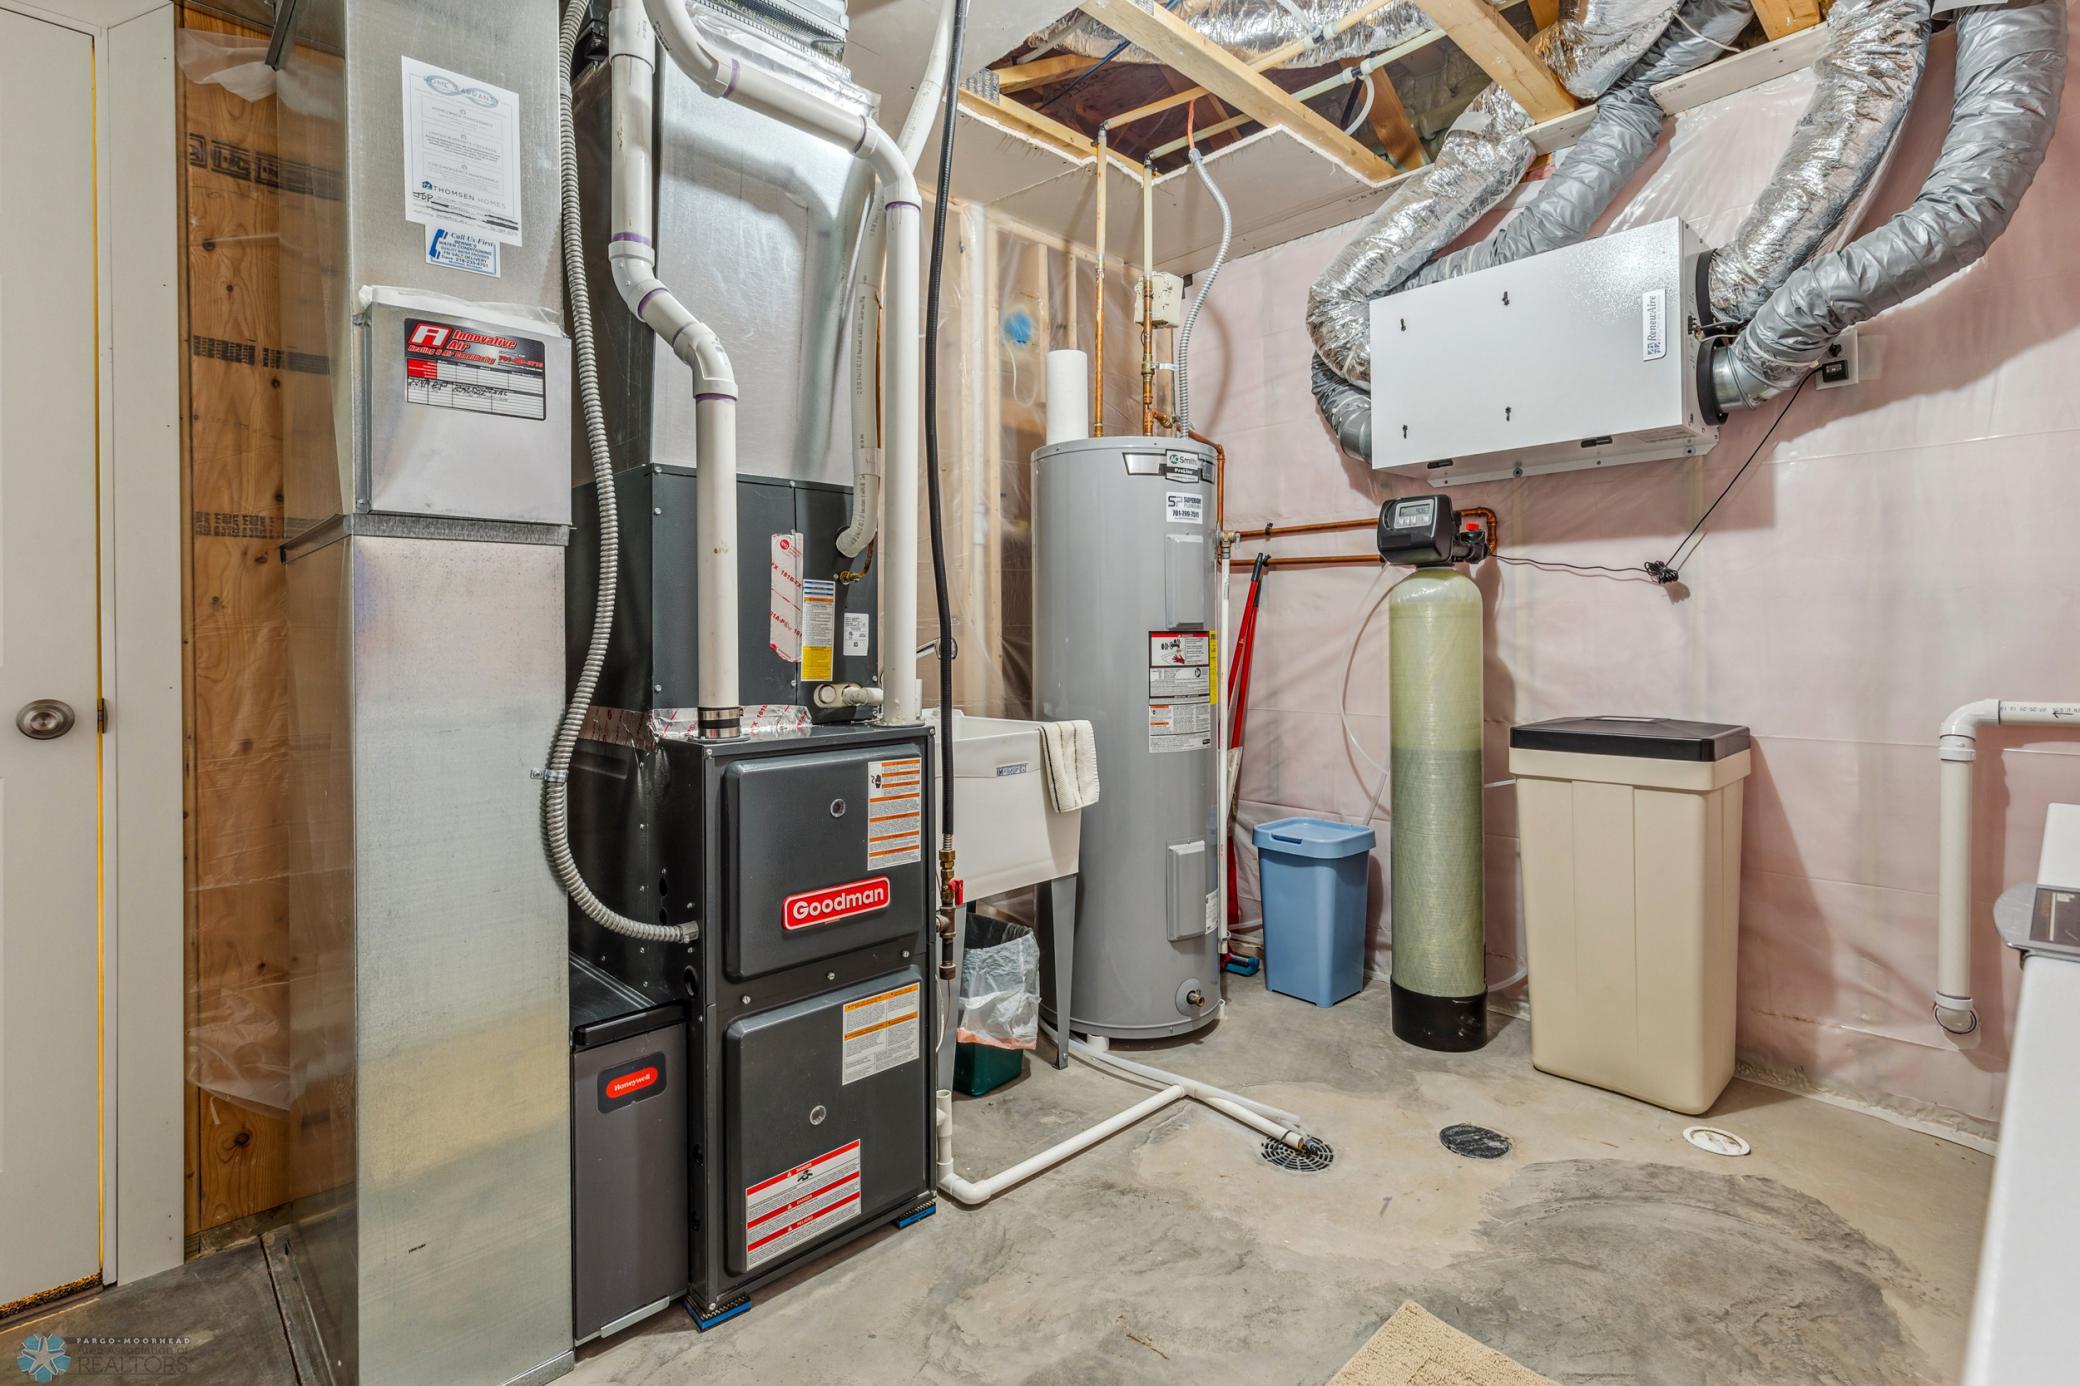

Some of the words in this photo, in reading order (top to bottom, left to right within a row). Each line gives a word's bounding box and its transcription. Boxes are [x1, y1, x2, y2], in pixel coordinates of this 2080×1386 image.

[433, 185, 475, 201] THOMSEN
[447, 340, 470, 351] Air
[452, 330, 517, 348] Innovative
[1180, 456, 1197, 466] Smith
[792, 888, 884, 920] Goodman
[614, 1073, 651, 1092] Honeywell
